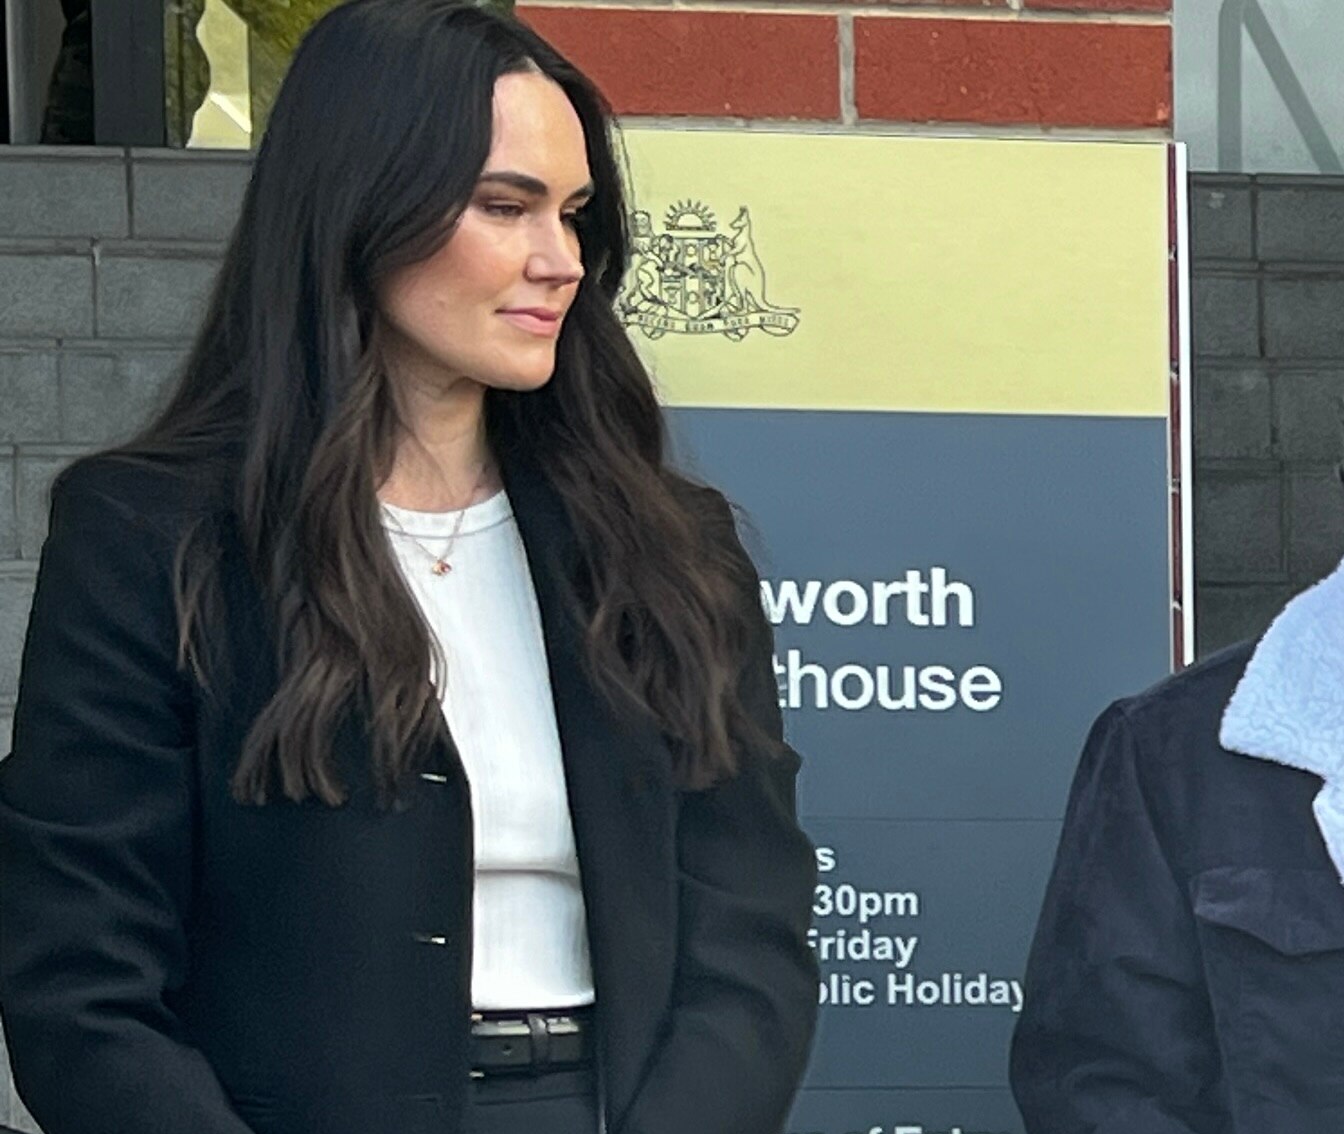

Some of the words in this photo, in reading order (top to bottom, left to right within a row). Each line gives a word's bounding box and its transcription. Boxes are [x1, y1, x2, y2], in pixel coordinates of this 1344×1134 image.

[760, 567, 973, 626] worth
[772, 650, 1001, 710] house
[813, 885, 918, 923] 30pm
[819, 974, 874, 1004] lic
